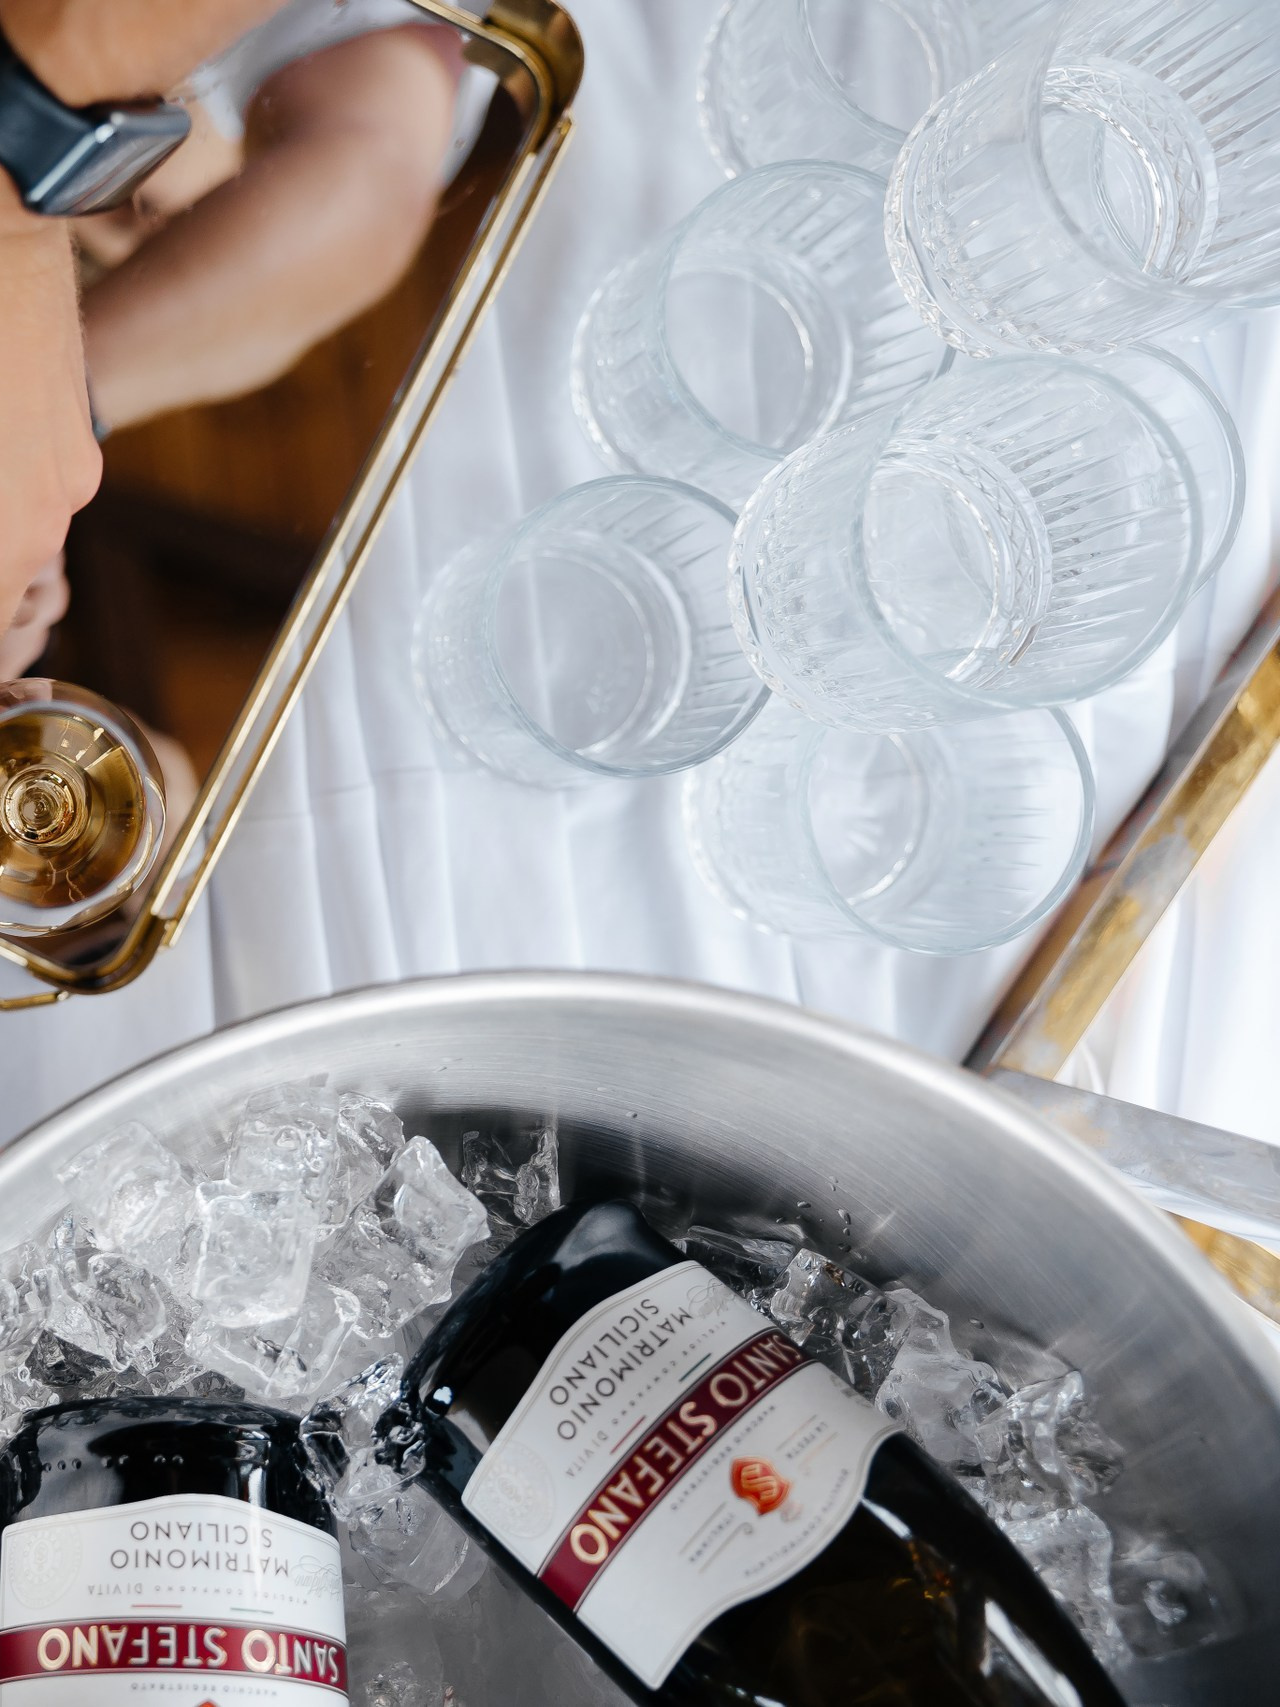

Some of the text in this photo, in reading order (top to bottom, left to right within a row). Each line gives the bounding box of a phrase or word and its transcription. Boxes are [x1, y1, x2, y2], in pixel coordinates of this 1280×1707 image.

[549, 1298, 660, 1405] SICILIANO
[557, 1307, 692, 1440] MATRIMONIO
[570, 1334, 802, 1565] SANTO STEFANO
[110, 1549, 289, 1576] MATRIMONIO
[37, 1625, 338, 1683] SANTO STEFANO
